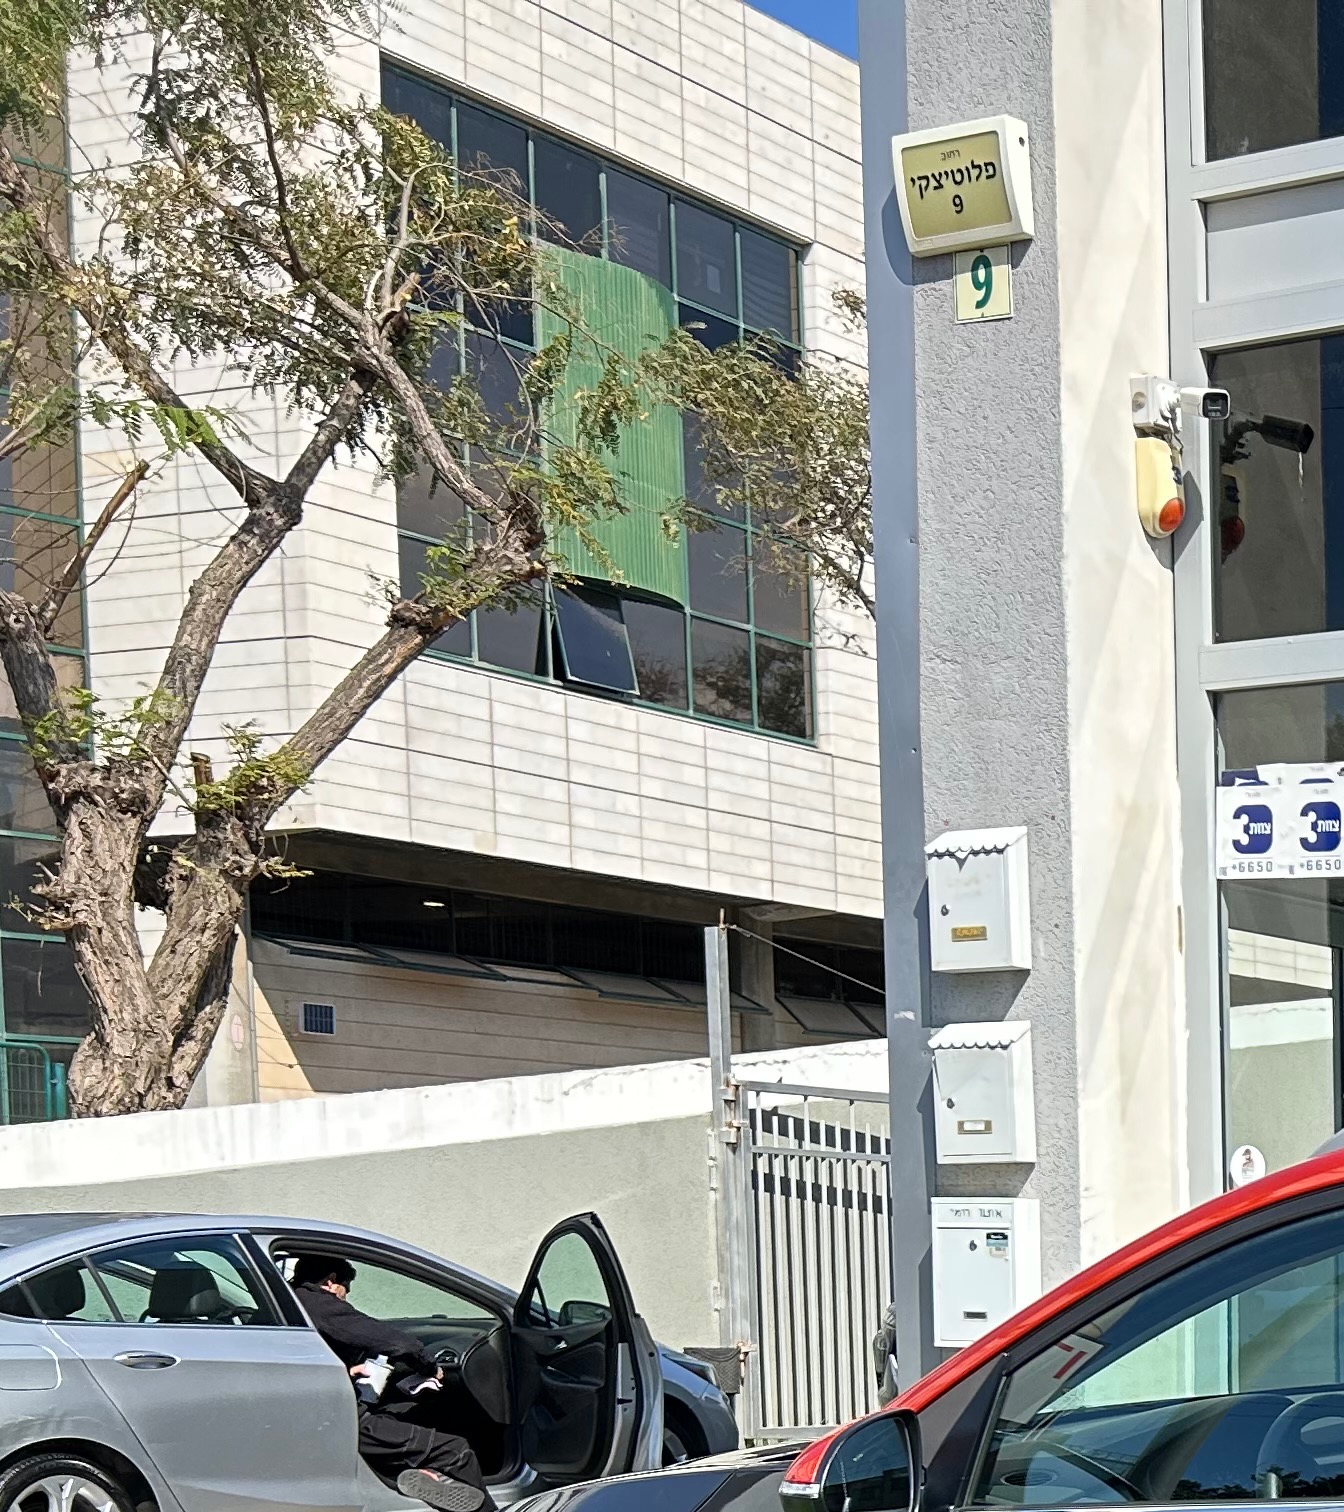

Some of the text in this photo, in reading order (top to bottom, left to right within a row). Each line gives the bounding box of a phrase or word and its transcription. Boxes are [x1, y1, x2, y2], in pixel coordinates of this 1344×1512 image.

[910, 159, 997, 200] פלוטיצקי
[952, 194, 964, 214] 9
[970, 254, 993, 310] 9
[1249, 822, 1272, 835] צוות
[1317, 819, 1340, 833] צוות
